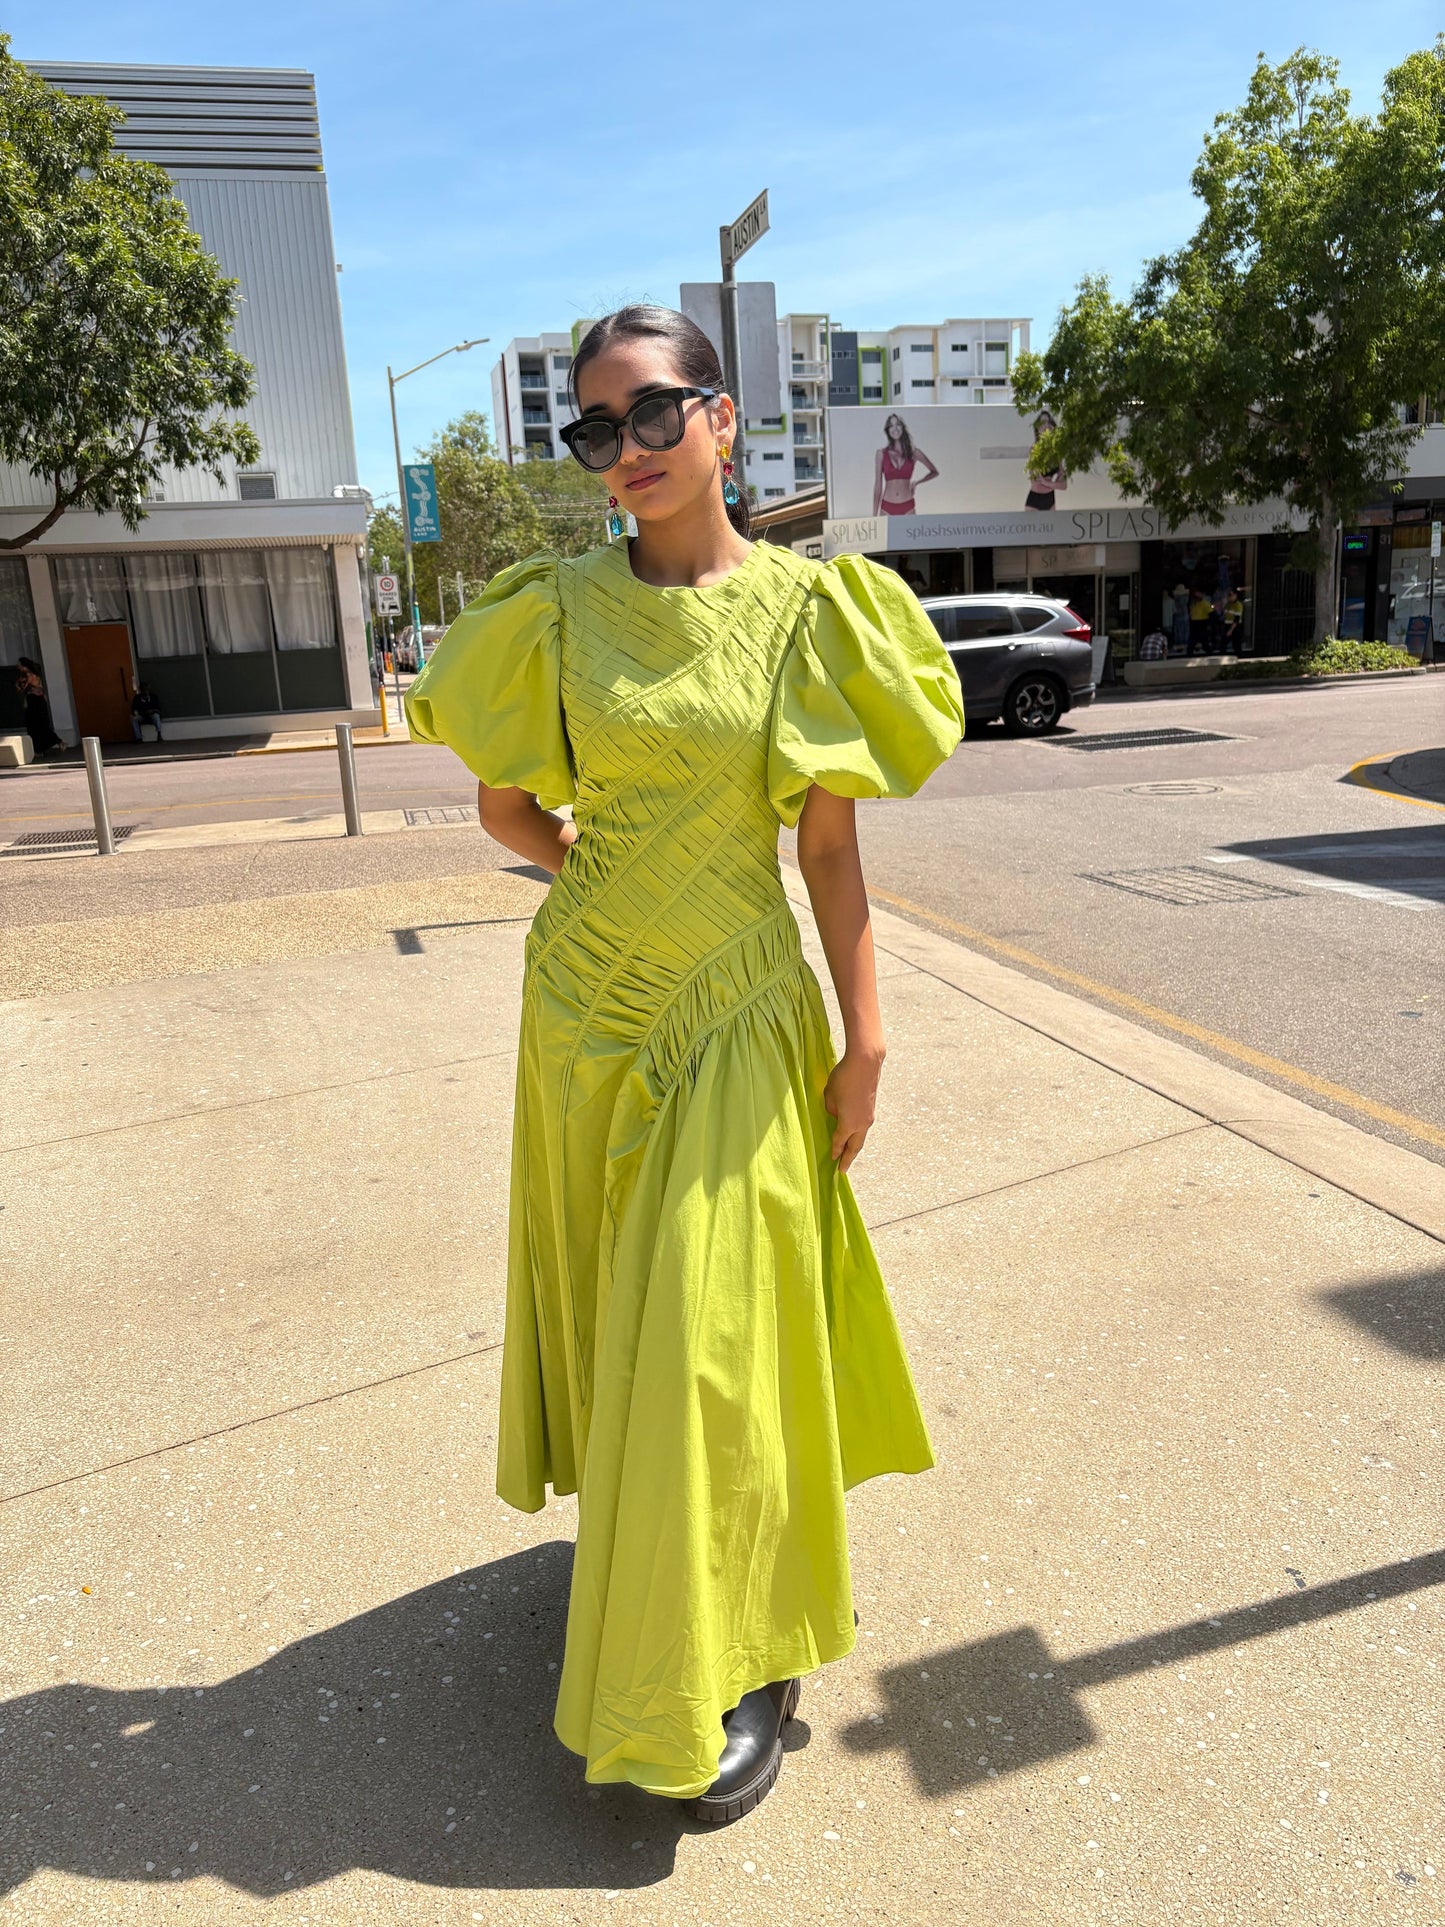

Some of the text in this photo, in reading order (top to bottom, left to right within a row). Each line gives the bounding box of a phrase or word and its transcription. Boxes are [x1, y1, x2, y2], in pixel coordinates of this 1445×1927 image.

[733, 204, 760, 256] AUSTIN
[832, 520, 878, 545] SPLASH
[906, 522, 1054, 541] splashswimwear.com.au
[1072, 509, 1175, 541] SPLASH
[1347, 541, 1364, 550] OPEN
